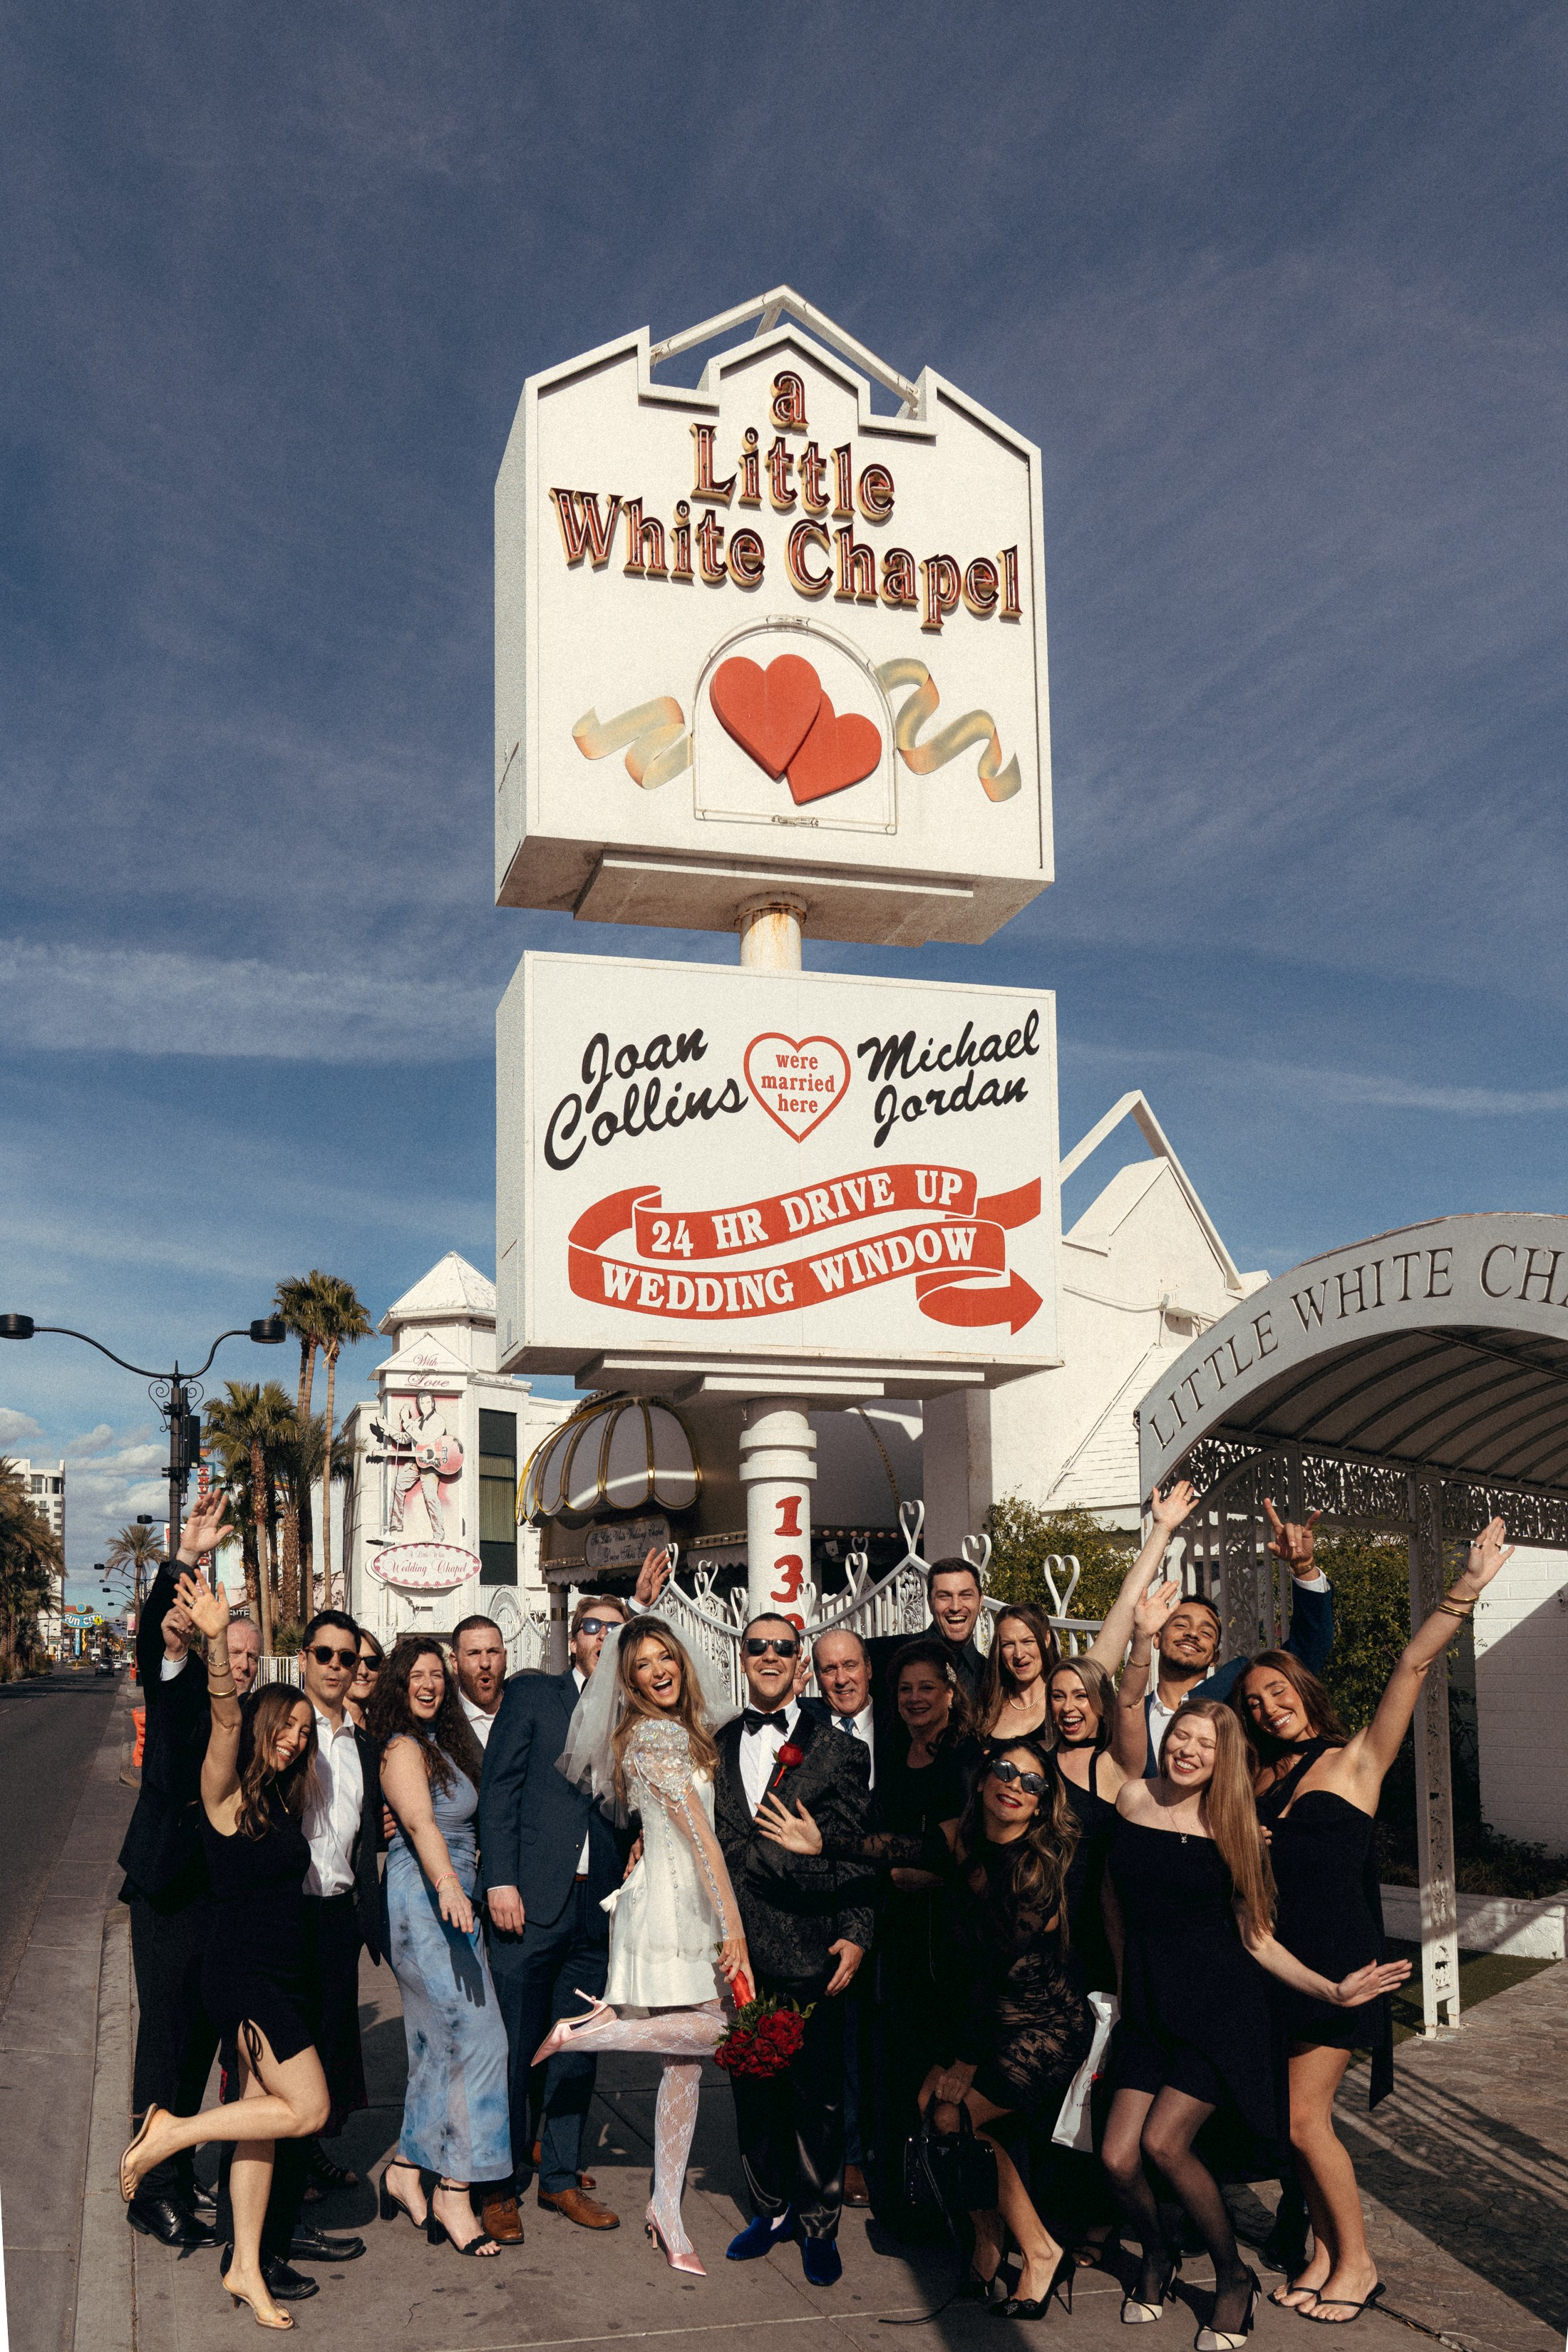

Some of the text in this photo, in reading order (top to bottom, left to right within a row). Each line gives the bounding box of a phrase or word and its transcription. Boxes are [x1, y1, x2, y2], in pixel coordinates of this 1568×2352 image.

[770, 370, 809, 429] a
[690, 423, 895, 522] Little
[550, 488, 1023, 631] White Chapel
[582, 1028, 708, 1112] Joan
[775, 1053, 818, 1069] were
[857, 1009, 1040, 1082] Michael
[761, 1074, 835, 1093] married
[778, 1095, 818, 1114] here
[874, 1070, 1029, 1147] Jordan
[544, 1078, 748, 1171] Collins
[651, 1170, 963, 1257] 24 HR DRIVE UP
[602, 1227, 977, 1313] WEDDING WINDOW
[404, 1372, 450, 1388] Love
[413, 1353, 439, 1366] With
[1148, 1244, 1568, 1451] LITTLE WHITE CH
[383, 1558, 467, 1577] Wedding Chapel
